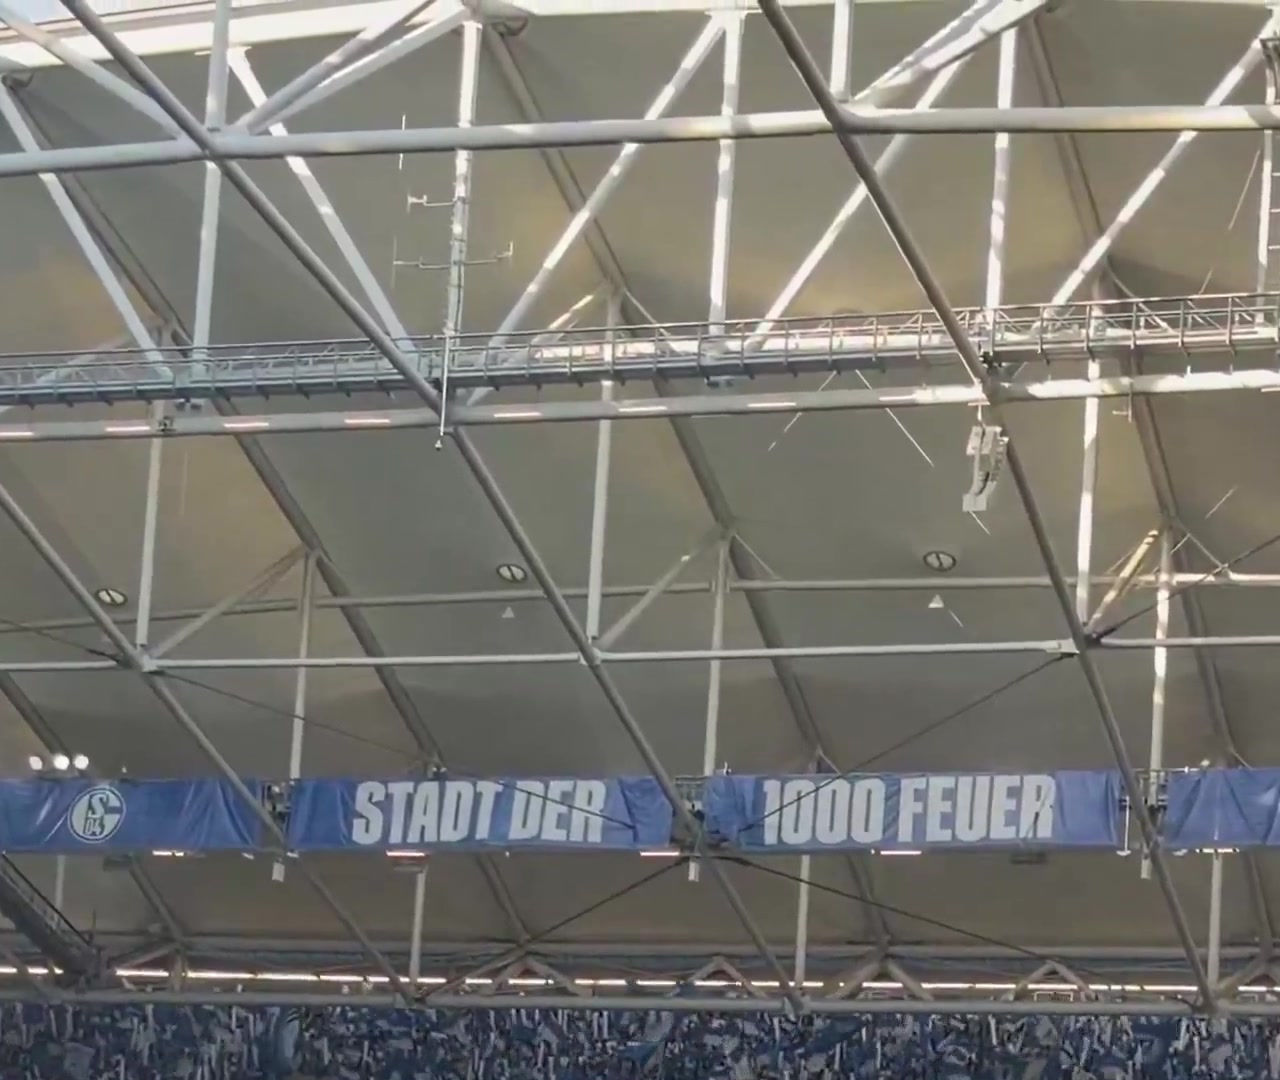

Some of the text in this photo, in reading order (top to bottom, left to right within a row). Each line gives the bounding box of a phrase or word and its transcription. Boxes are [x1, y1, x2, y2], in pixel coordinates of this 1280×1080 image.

[352, 779, 606, 845] STADT DER
[762, 774, 1055, 845] 1000 FEUER
